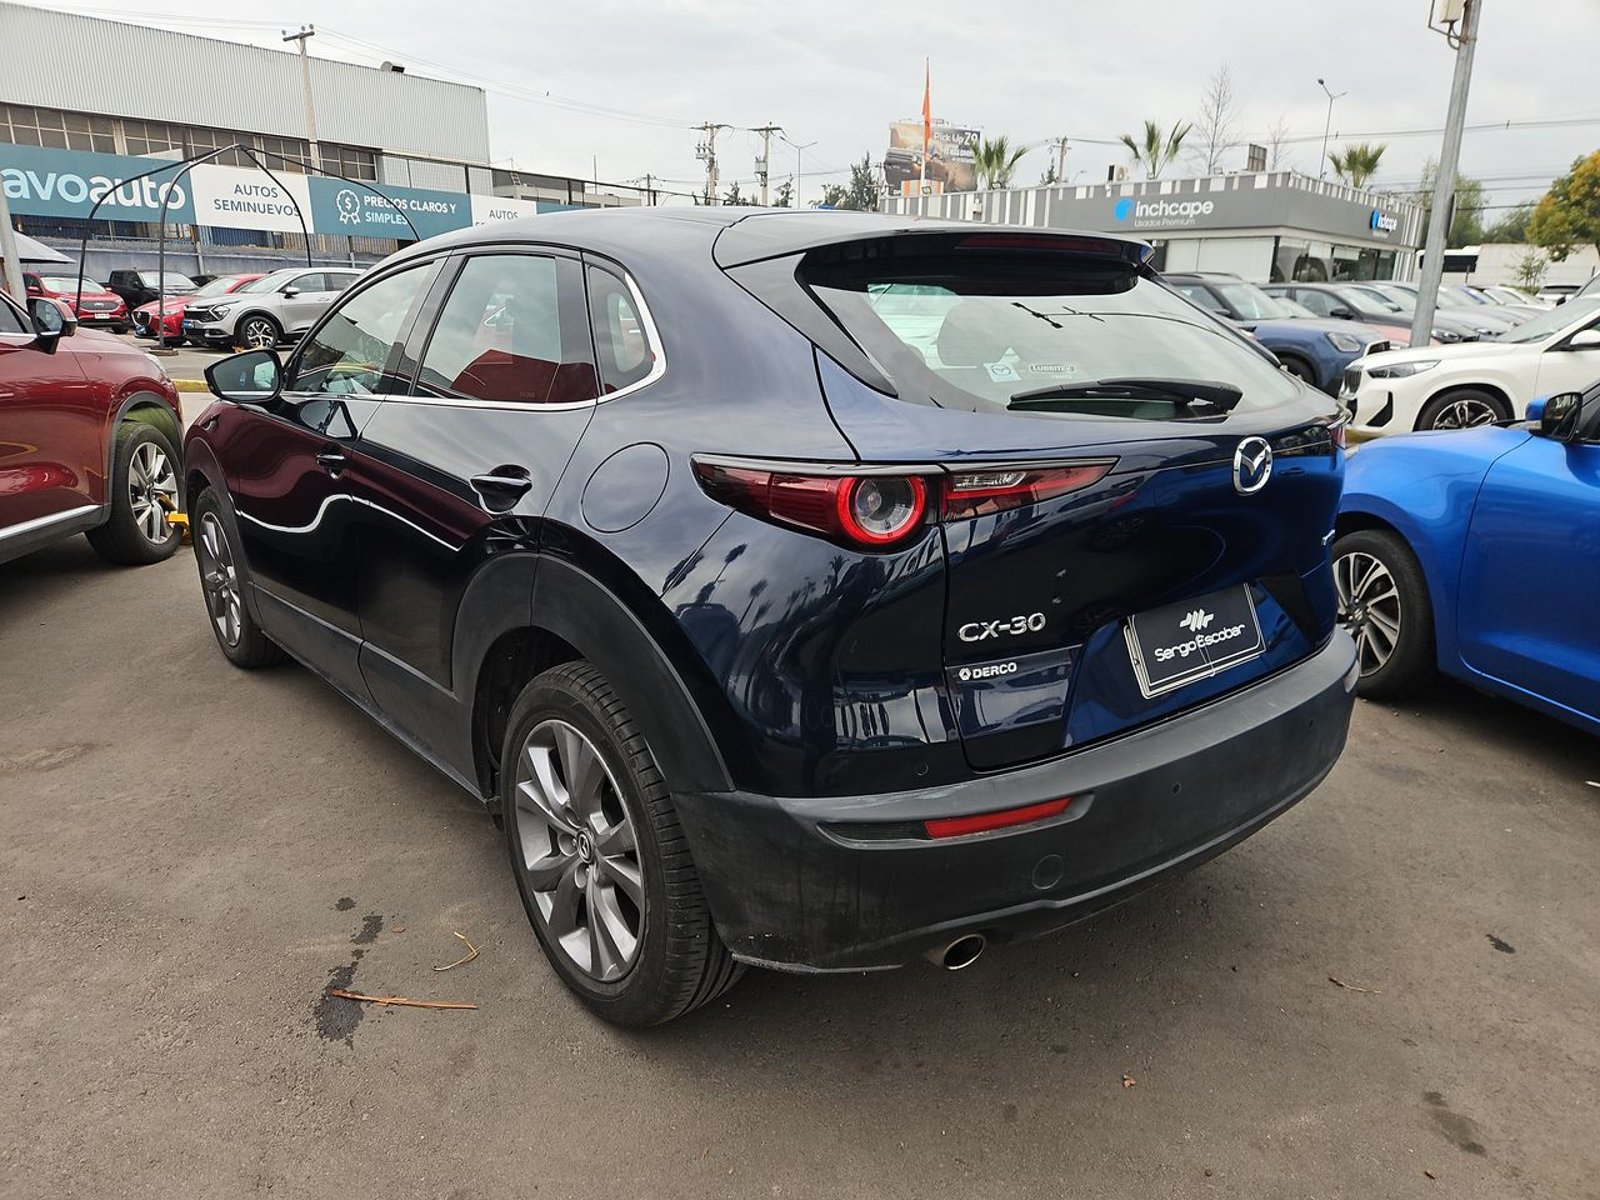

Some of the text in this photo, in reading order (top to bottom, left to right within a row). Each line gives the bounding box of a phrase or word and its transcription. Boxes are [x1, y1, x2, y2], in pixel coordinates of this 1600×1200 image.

[234, 184, 278, 198] AUTOS
[213, 199, 301, 217] SEMINUEVOS
[364, 195, 457, 214] PRECIOS CLAROS Y
[1135, 200, 1214, 218] inchcape
[365, 211, 408, 226] SIMPLES
[489, 209, 519, 219] AUTOS
[1134, 220, 1160, 228] Usados
[959, 612, 1046, 642] CX-30
[972, 662, 1017, 679] DERCO
